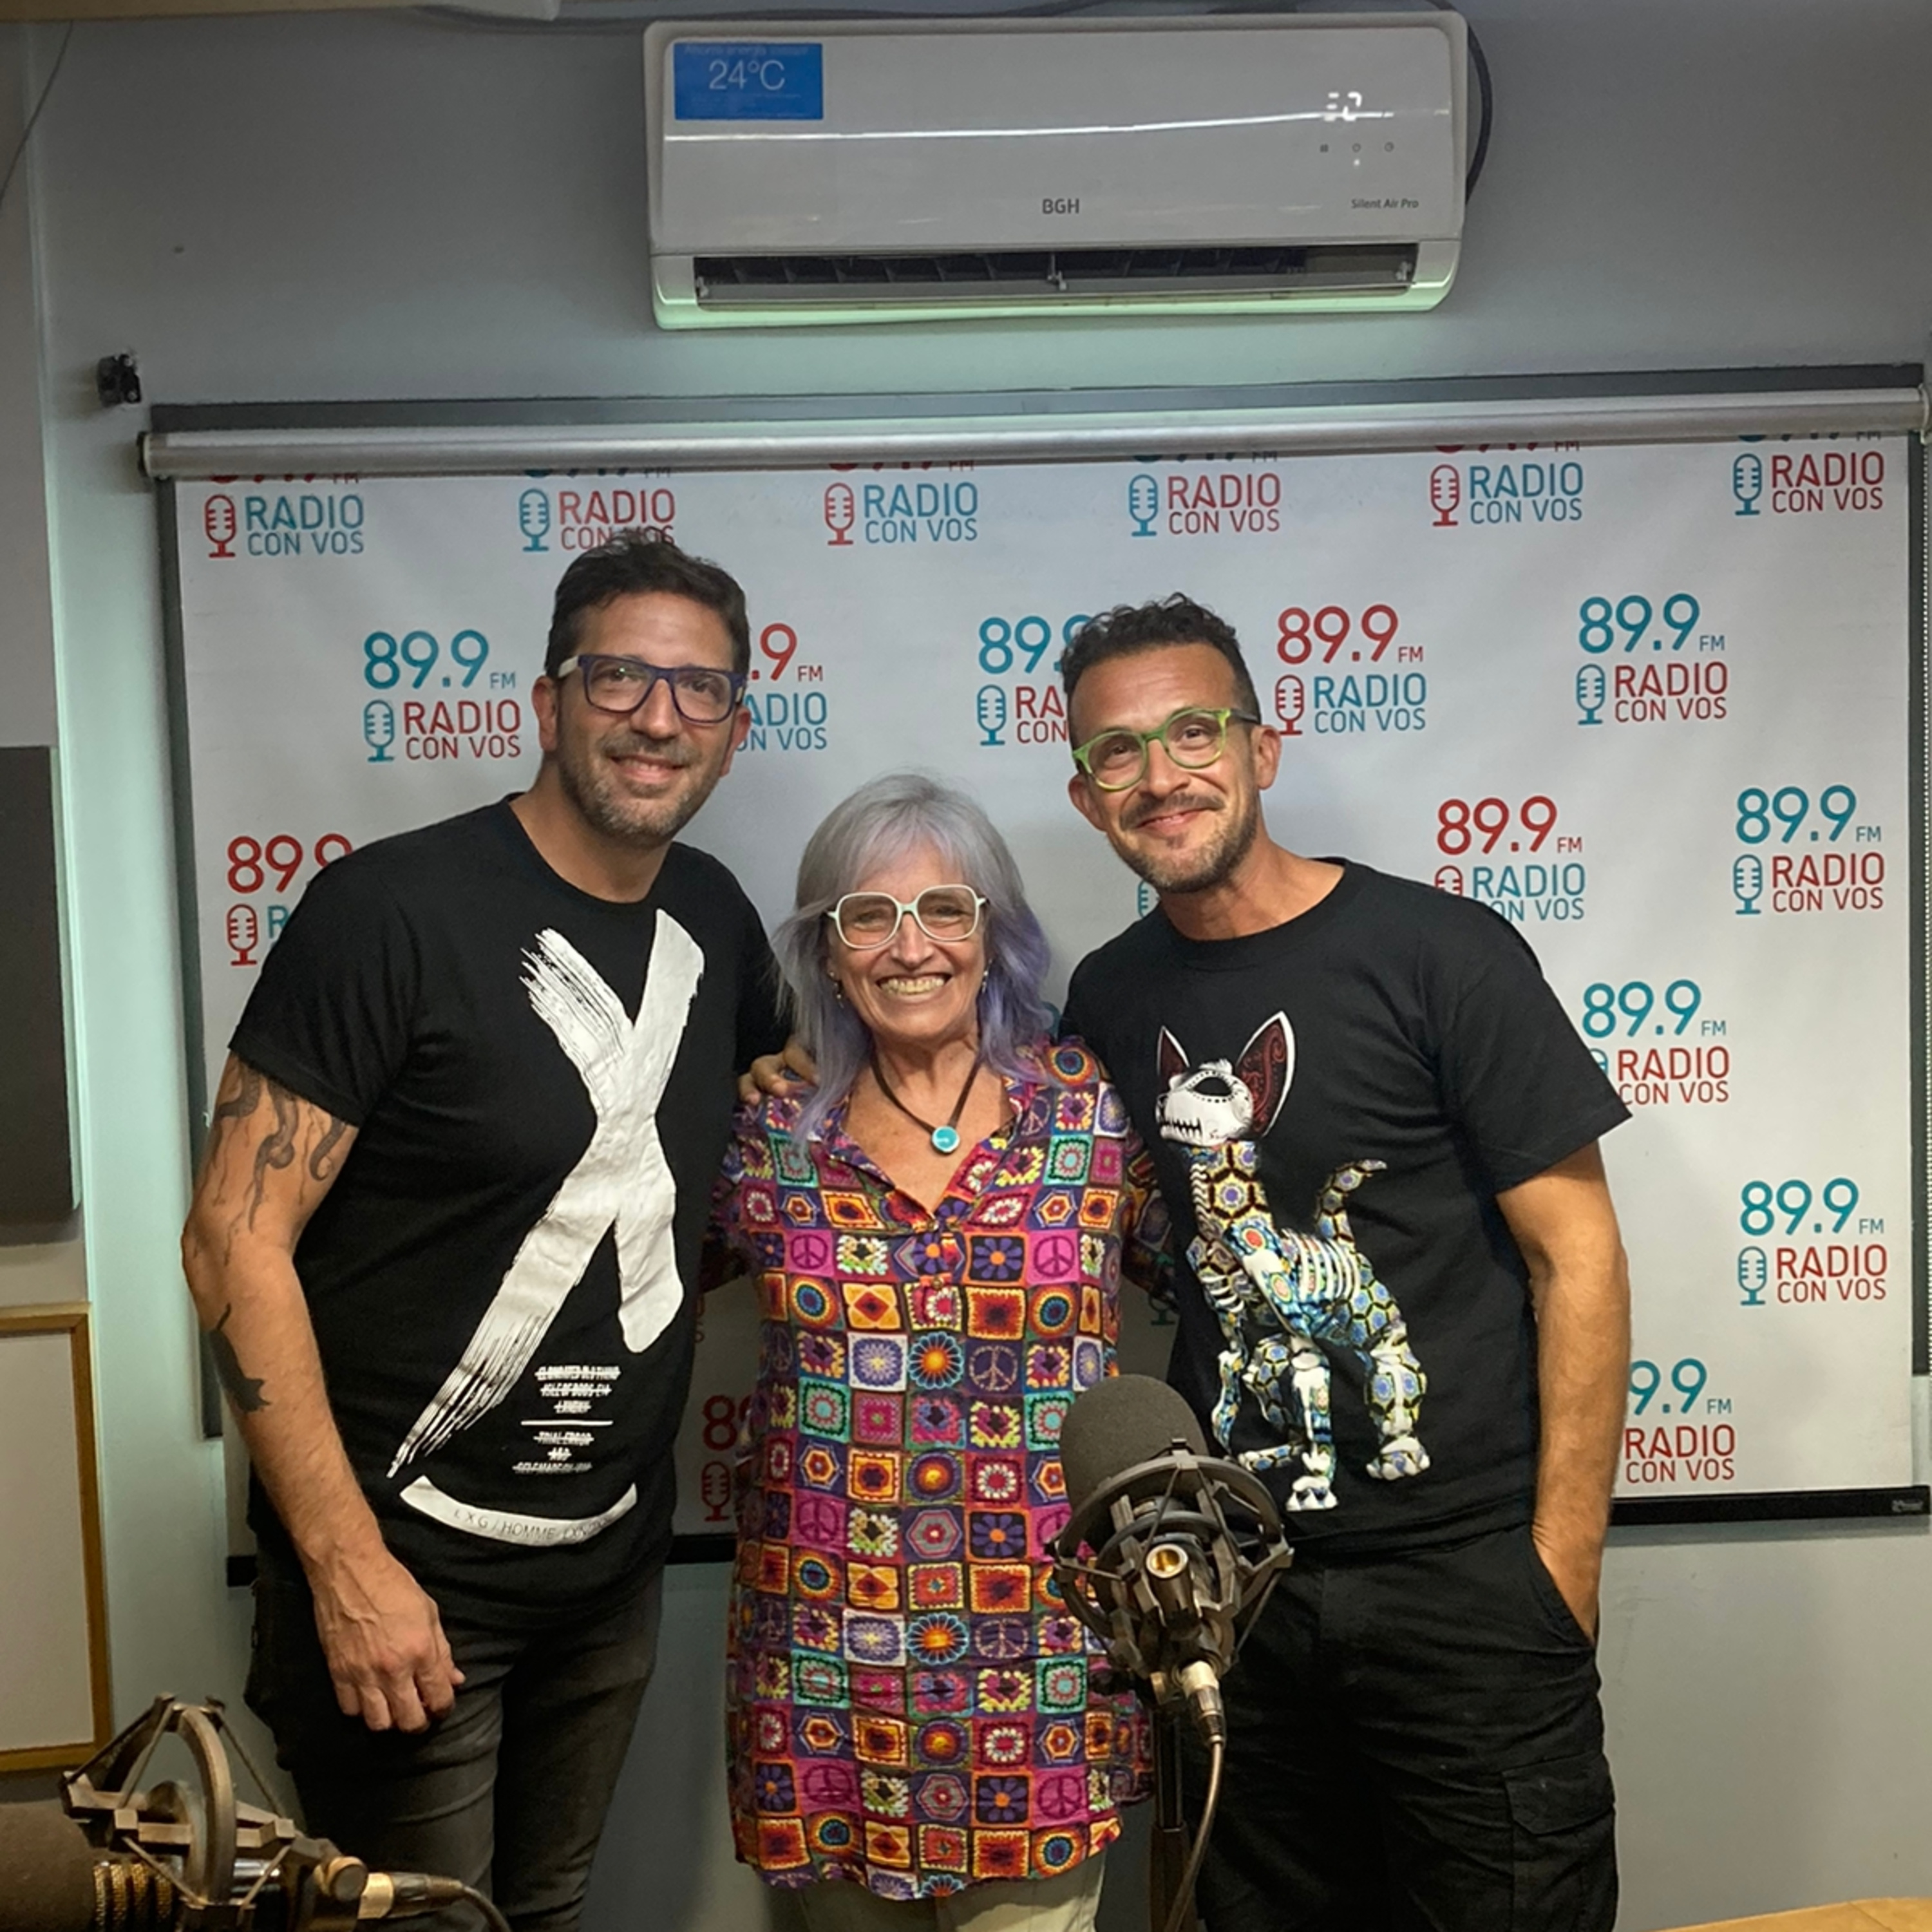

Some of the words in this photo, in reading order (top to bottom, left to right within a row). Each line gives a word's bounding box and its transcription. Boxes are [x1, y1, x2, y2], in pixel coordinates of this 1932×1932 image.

[709, 59, 785, 90] 24°C
[1043, 198, 1079, 214] BGH
[1351, 199, 1381, 209] Silent
[1384, 198, 1399, 208] Air
[1401, 198, 1419, 208] Pro
[1470, 462, 1583, 499] RADIO
[1772, 451, 1884, 488] RADIO
[560, 489, 675, 524] RADIO
[864, 482, 978, 518] RADIO
[1168, 473, 1280, 509] RADIO
[1773, 489, 1823, 513] CON
[1833, 487, 1883, 511] VOS
[245, 495, 363, 531] RADIO
[1170, 511, 1219, 535] CON
[1229, 509, 1280, 532] VOS
[1471, 501, 1521, 524] CON
[1532, 498, 1582, 522] VOS
[248, 532, 300, 556] CON
[310, 531, 363, 554] VOS
[866, 520, 916, 544] CON
[927, 518, 977, 542] VOS
[1278, 605, 1398, 664] 89.9
[1399, 646, 1423, 663] FM
[1580, 593, 1700, 653] 89.9
[1700, 635, 1725, 651] FM
[364, 629, 489, 689] 89.9
[490, 672, 515, 688] FM
[798, 665, 822, 681] FM
[1314, 673, 1426, 709] RADIO
[1615, 661, 1727, 699] RADIO
[404, 699, 520, 735] RADIO
[744, 692, 827, 726] ADIO
[1315, 710, 1365, 734] CON
[1376, 708, 1426, 731] VOS
[1615, 699, 1665, 723] CON
[1677, 696, 1727, 720] VOS
[406, 737, 458, 760] CON
[469, 735, 520, 758] VOS
[777, 727, 827, 750] VOS
[1017, 720, 1067, 744] CON
[1437, 796, 1557, 855] 89.9
[1557, 837, 1582, 853] FM
[1736, 785, 1857, 844] 89.9
[1856, 826, 1881, 842] FM
[1473, 863, 1585, 898] RADIO
[1773, 852, 1884, 889] RADIO
[1535, 899, 1584, 920] VOS
[1774, 889, 1823, 913] CON
[1833, 887, 1883, 910] VOS
[1582, 979, 1701, 1038] 89.9
[1701, 1020, 1726, 1036] FM
[1618, 1046, 1728, 1083] RADIO
[1619, 1083, 1669, 1105] CON
[1679, 1080, 1728, 1103] VOS
[1741, 1178, 1859, 1236] 89.9
[1859, 1218, 1884, 1234] FM
[1777, 1244, 1886, 1281] RADIO
[1777, 1280, 1826, 1303] CON
[1837, 1278, 1886, 1300] VOS
[1629, 1358, 1707, 1416] 9.9
[1707, 1399, 1731, 1414] FM
[1625, 1424, 1735, 1460] RADIO
[1626, 1461, 1675, 1483] CON
[1685, 1458, 1734, 1481] VOS
